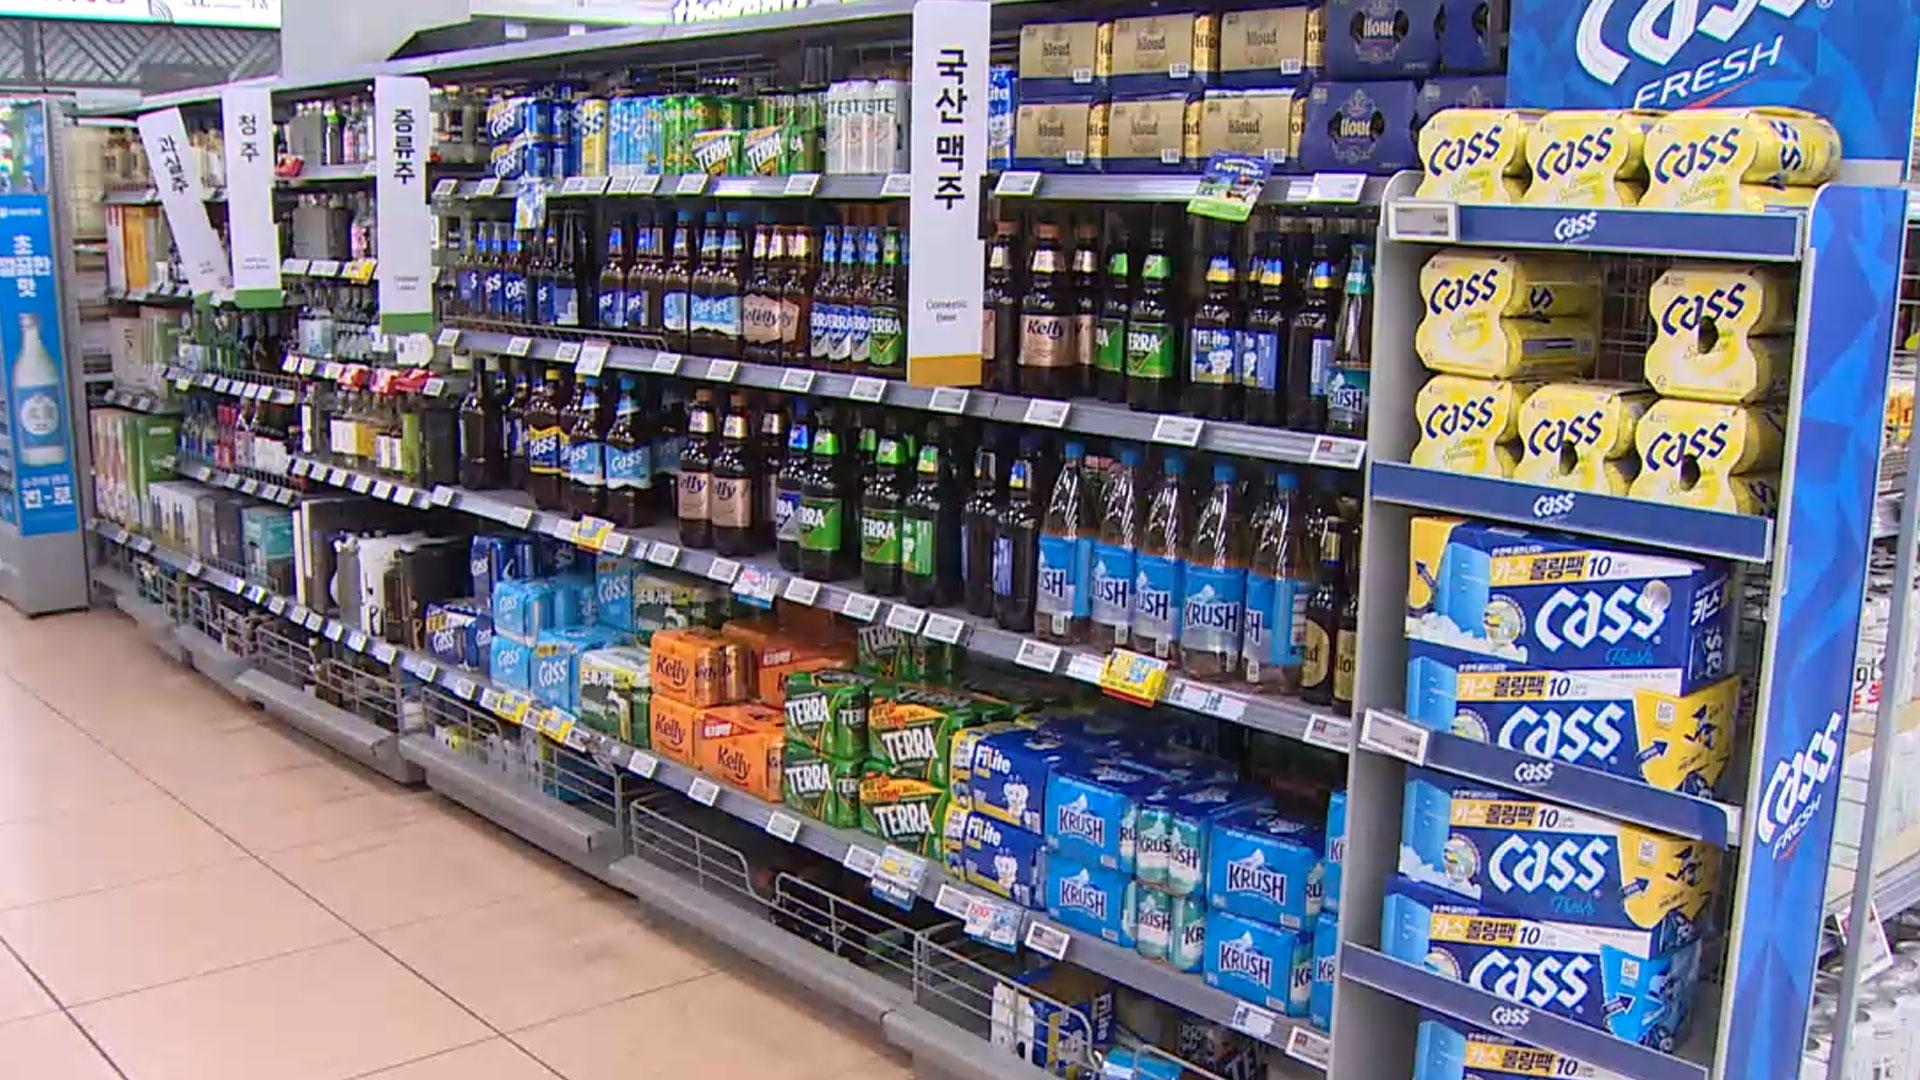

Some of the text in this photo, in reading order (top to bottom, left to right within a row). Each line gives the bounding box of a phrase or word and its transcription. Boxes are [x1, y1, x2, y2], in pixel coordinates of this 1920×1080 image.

[1577, 0, 1808, 85] Ca
[1634, 35, 1783, 109] FRESH
[238, 114, 260, 163] 청주
[394, 109, 415, 185] 증류주
[934, 48, 968, 210] 국산맥주
[694, 136, 732, 173] TERRA
[747, 133, 783, 173] TERRA
[1428, 125, 1502, 177] Cass
[1536, 127, 1614, 181] Cass
[1655, 127, 1740, 184] Cass
[1554, 211, 1598, 242] Cass
[926, 299, 967, 310] Domestic
[1430, 268, 1498, 315] Cass
[1662, 282, 1747, 336] Cass
[1026, 319, 1063, 340] Kelly
[1425, 396, 1494, 439] Cass
[1528, 410, 1604, 456] Cass
[611, 451, 642, 471] Cass
[1646, 421, 1730, 473] Cass
[1533, 493, 1575, 518] Cass
[1588, 556, 1612, 577] 10
[1185, 600, 1239, 633] KRUSH
[1535, 585, 1667, 651] Cass
[538, 659, 567, 687] Cass
[656, 654, 688, 687] Kelly
[1548, 676, 1571, 697] 10
[655, 713, 686, 746] Kelly
[785, 695, 831, 727] TERRA
[882, 727, 938, 765] TERRA
[1499, 702, 1626, 763] Cass
[717, 744, 751, 780] Kelly
[785, 763, 832, 796] TERRA
[1514, 761, 1554, 783] Cass
[1758, 711, 1842, 843] Cass
[873, 802, 935, 838] TERRA
[1060, 808, 1104, 846] KRUSH
[1537, 808, 1559, 828] 10
[1488, 833, 1610, 893] Cass
[1061, 880, 1107, 918] KRUSH
[1228, 862, 1286, 903] KRUSH
[1519, 926, 1541, 945] 10
[1220, 942, 1271, 986] KRUSH
[1469, 949, 1593, 1009] Cass
[1492, 1005, 1530, 1026] Cass
[1556, 1057, 1578, 1077] 10
